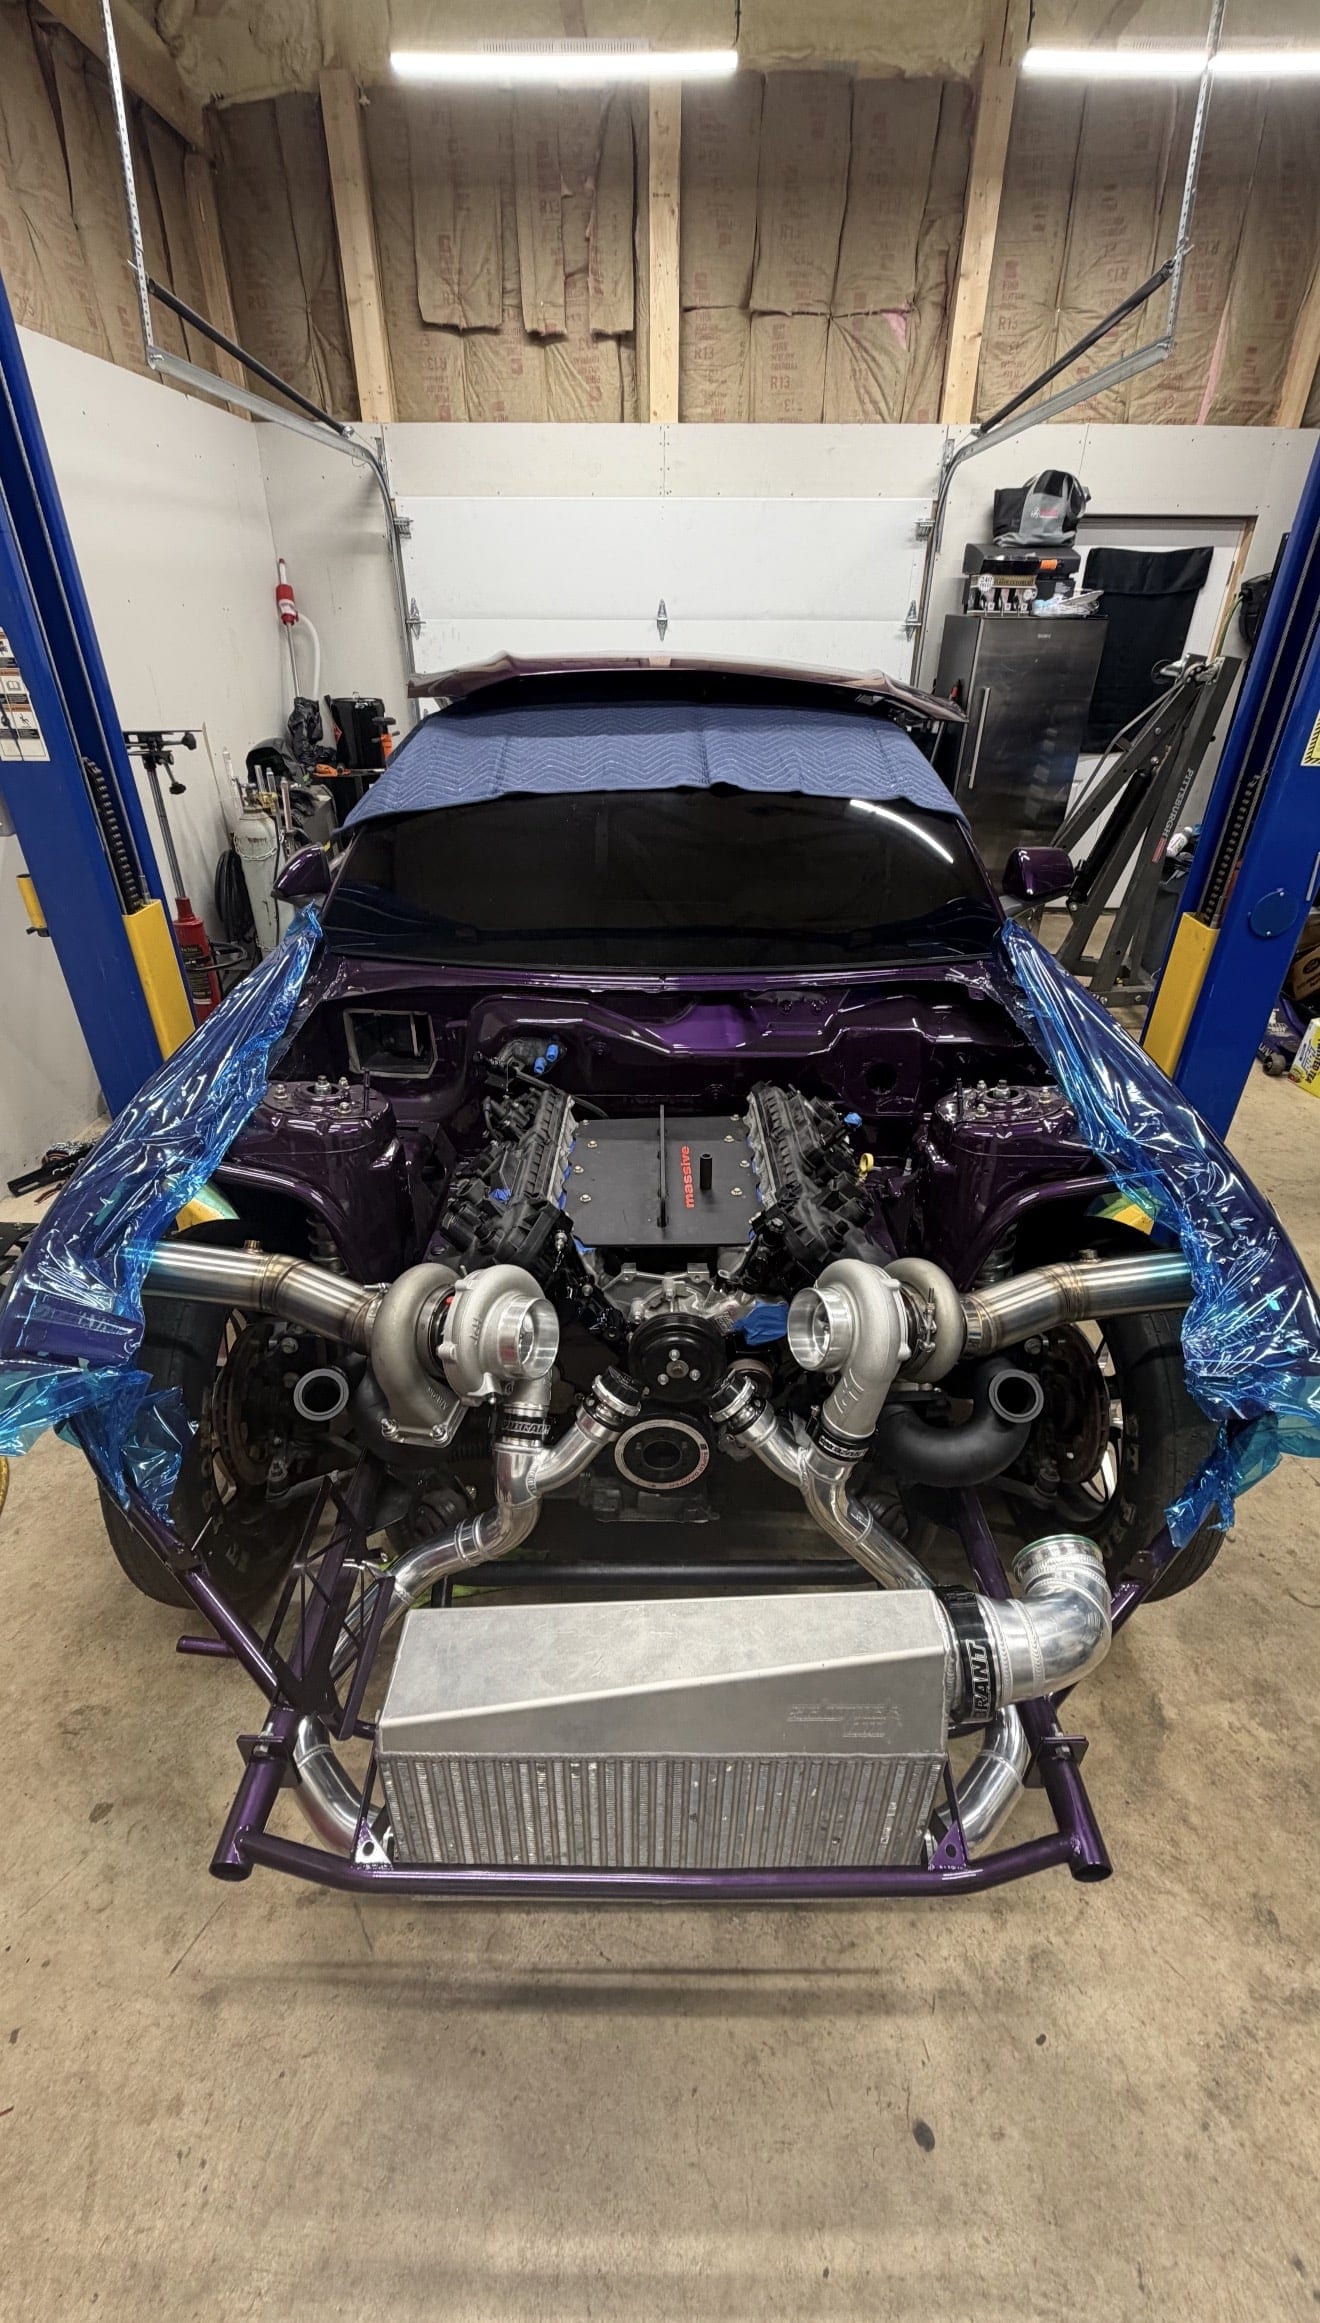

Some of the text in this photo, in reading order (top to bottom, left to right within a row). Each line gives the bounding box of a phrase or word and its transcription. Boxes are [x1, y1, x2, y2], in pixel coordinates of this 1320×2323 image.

[694, 346, 714, 360] R13
[770, 375, 790, 390] R13
[1163, 768, 1194, 839] PITTSBURGH
[681, 1145, 695, 1209] massive
